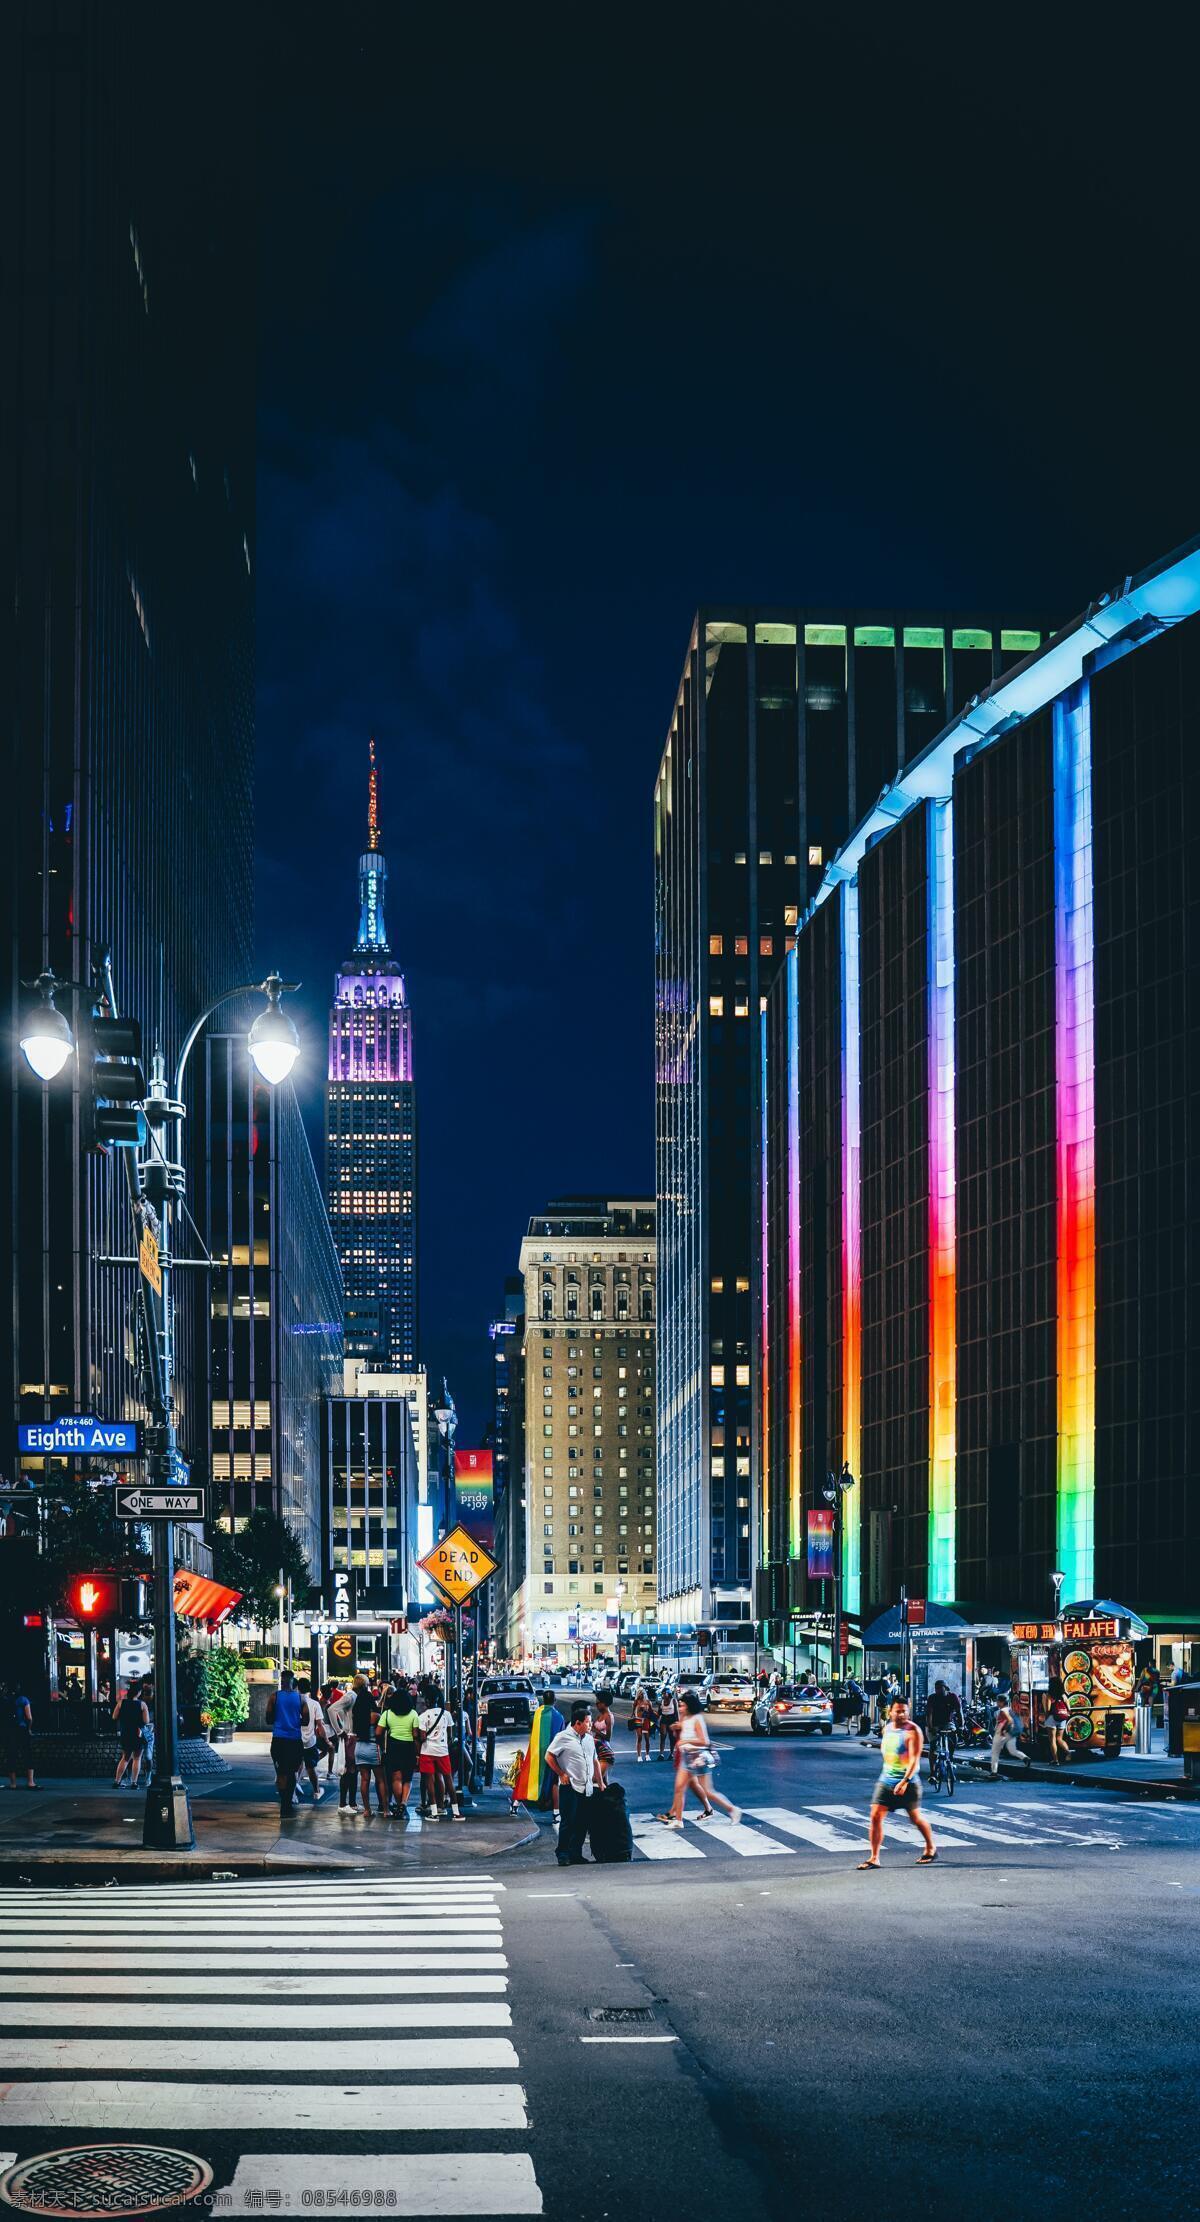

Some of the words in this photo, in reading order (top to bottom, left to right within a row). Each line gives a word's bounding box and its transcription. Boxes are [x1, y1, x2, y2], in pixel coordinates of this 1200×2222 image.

[27, 1428, 86, 1451] Eighth
[90, 1429, 127, 1447] Ave
[130, 1497, 154, 1508] ONE
[165, 1497, 191, 1508] WAY
[461, 1492, 488, 1505] pride
[438, 1550, 479, 1564] DEAD
[444, 1569, 473, 1582] END
[335, 1573, 350, 1622] PAR
